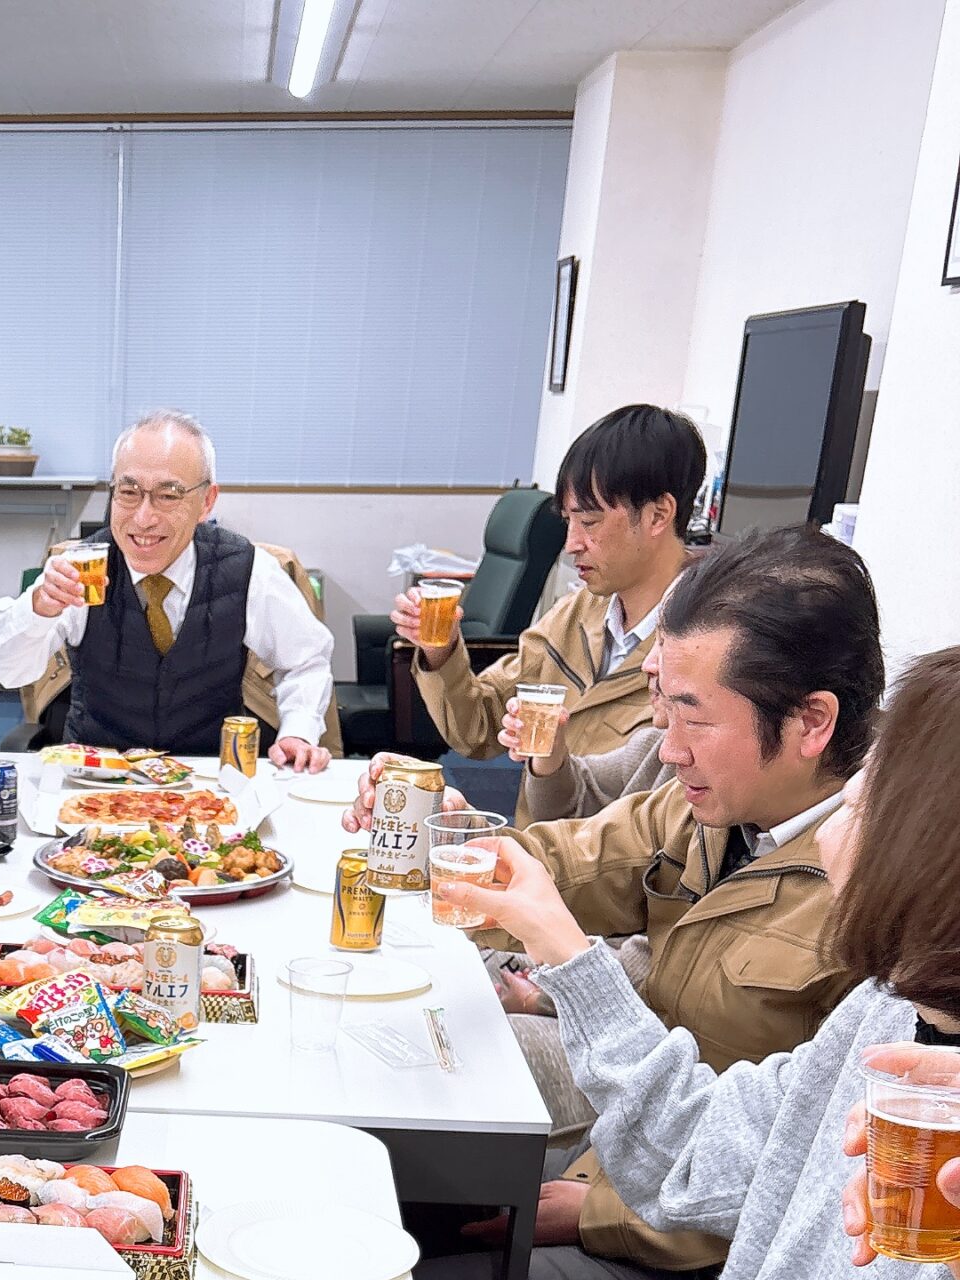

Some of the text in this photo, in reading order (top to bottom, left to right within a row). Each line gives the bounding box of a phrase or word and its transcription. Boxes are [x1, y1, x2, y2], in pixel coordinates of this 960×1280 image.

[342, 885, 377, 896] PREMI
[145, 980, 189, 998] マルエフ
